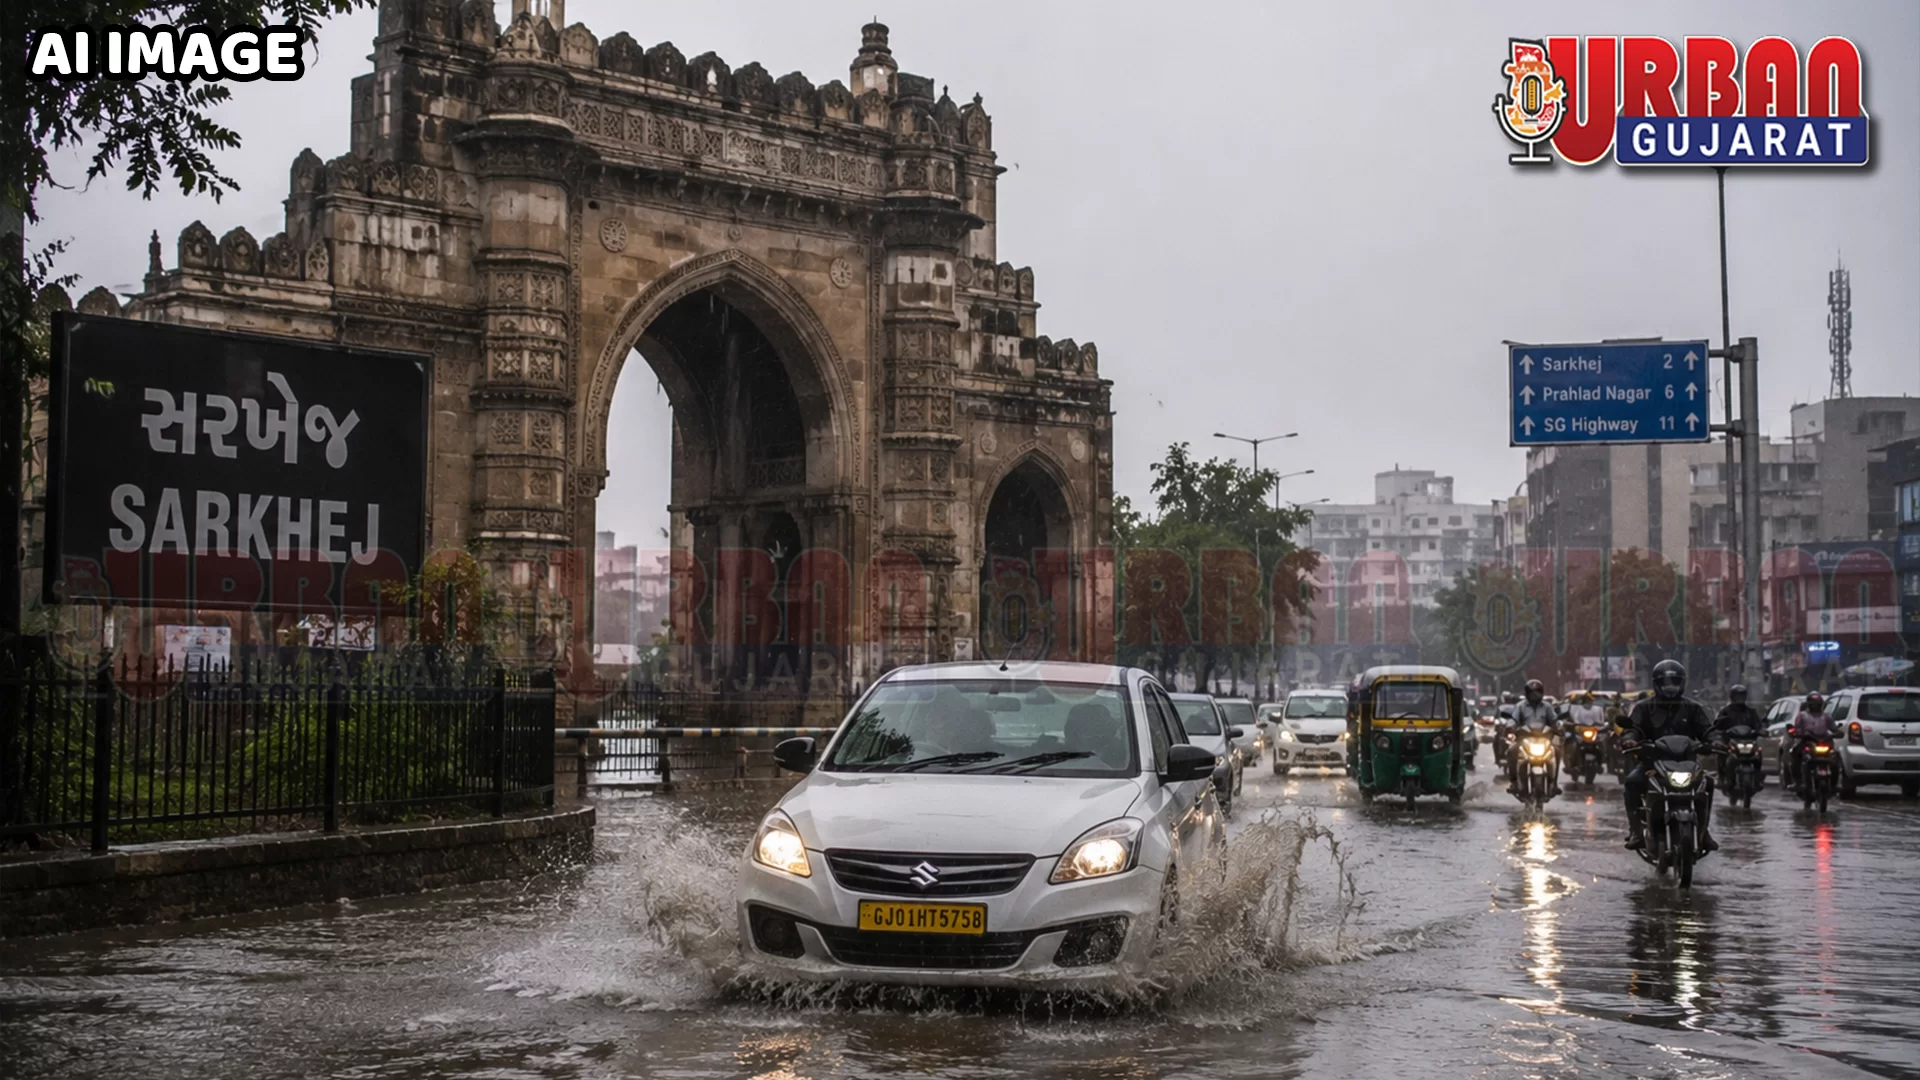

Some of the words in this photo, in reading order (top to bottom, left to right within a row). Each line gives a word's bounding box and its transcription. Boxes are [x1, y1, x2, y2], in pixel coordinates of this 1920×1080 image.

[1542, 356, 1603, 374] Sarkhej
[1663, 352, 1673, 369] 2
[1542, 386, 1601, 402] Prahlad
[1606, 386, 1652, 404] Nagar
[1665, 386, 1675, 399] 6
[141, 371, 361, 469] સરખેજ
[1543, 417, 1567, 432] SG
[1572, 416, 1639, 435] Highway
[1659, 415, 1675, 431] 11
[108, 483, 380, 566] SARKHEJ
[874, 907, 982, 929] GJ01HT5758
